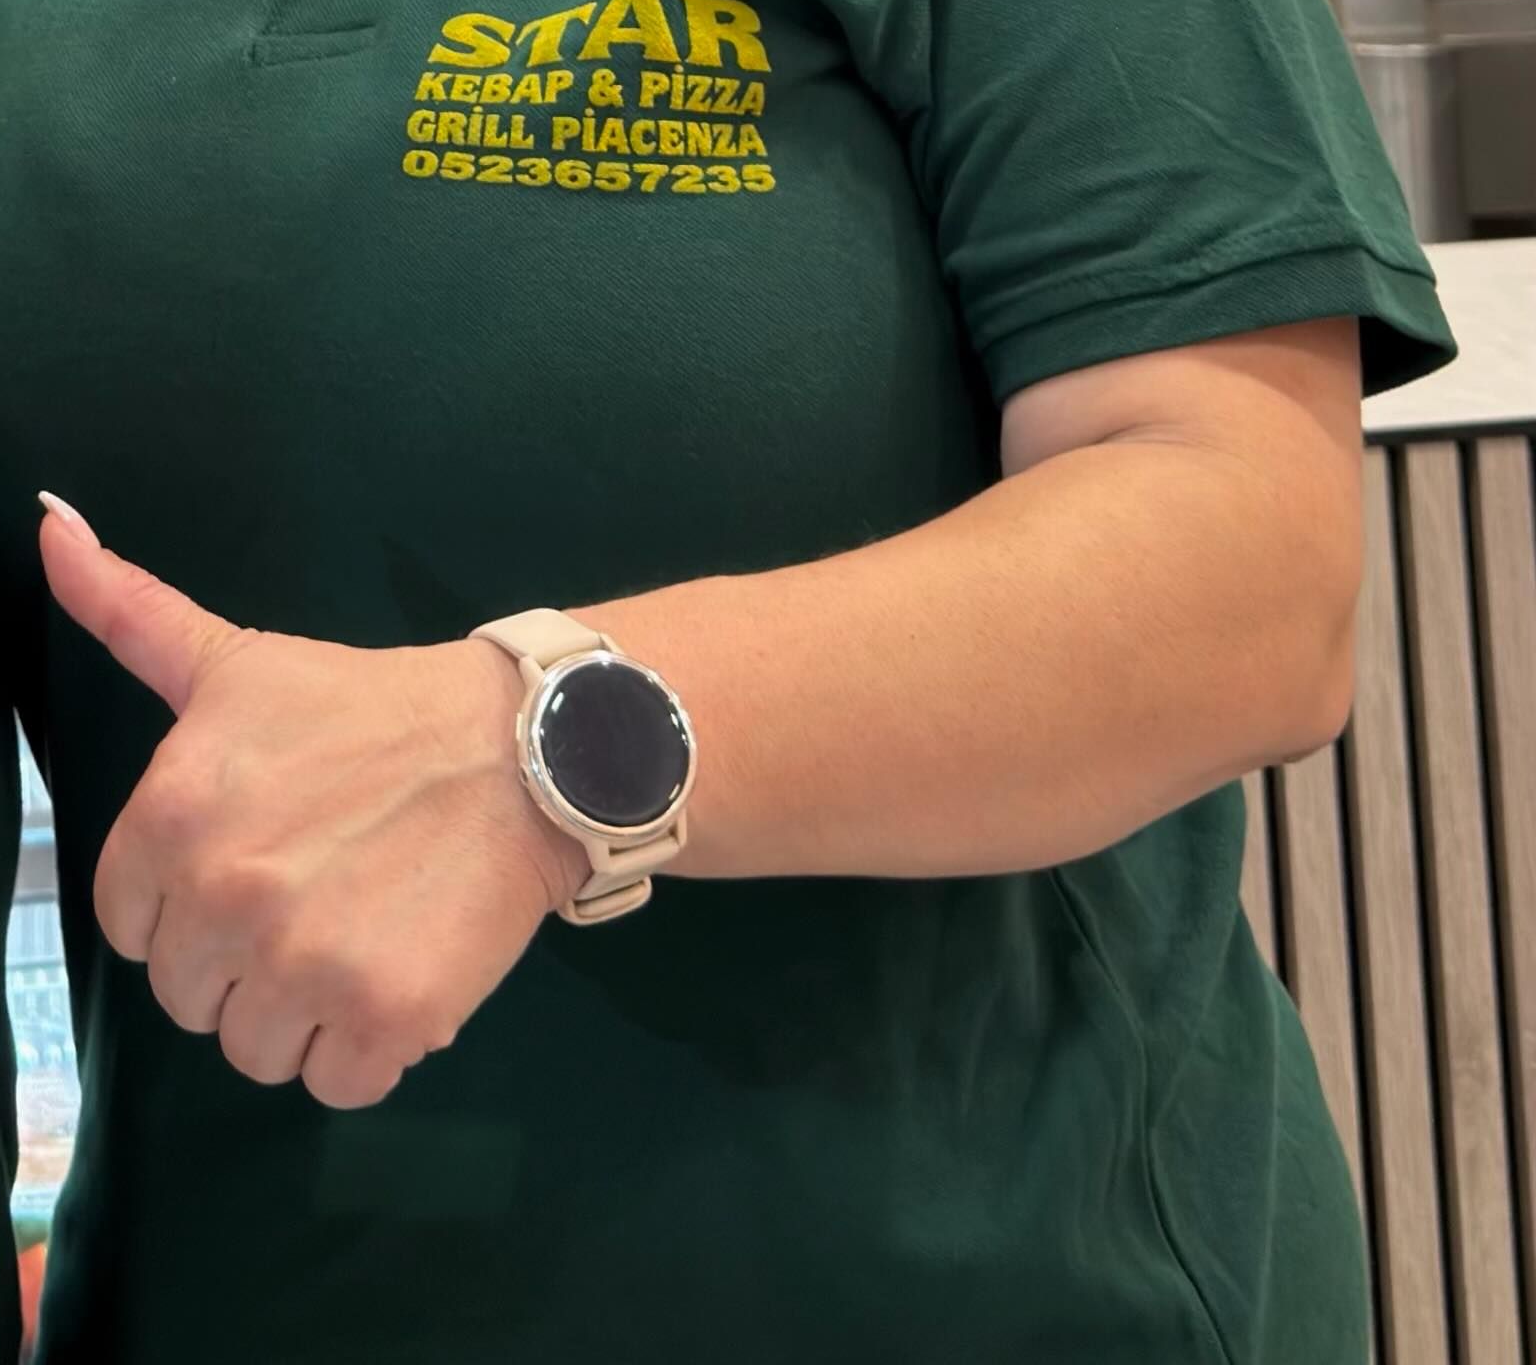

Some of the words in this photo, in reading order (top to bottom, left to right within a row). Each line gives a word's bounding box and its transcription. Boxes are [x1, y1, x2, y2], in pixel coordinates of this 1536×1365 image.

[415, 69, 574, 104] KEBAP
[588, 68, 624, 107] &
[402, 149, 775, 192] 0523657235
